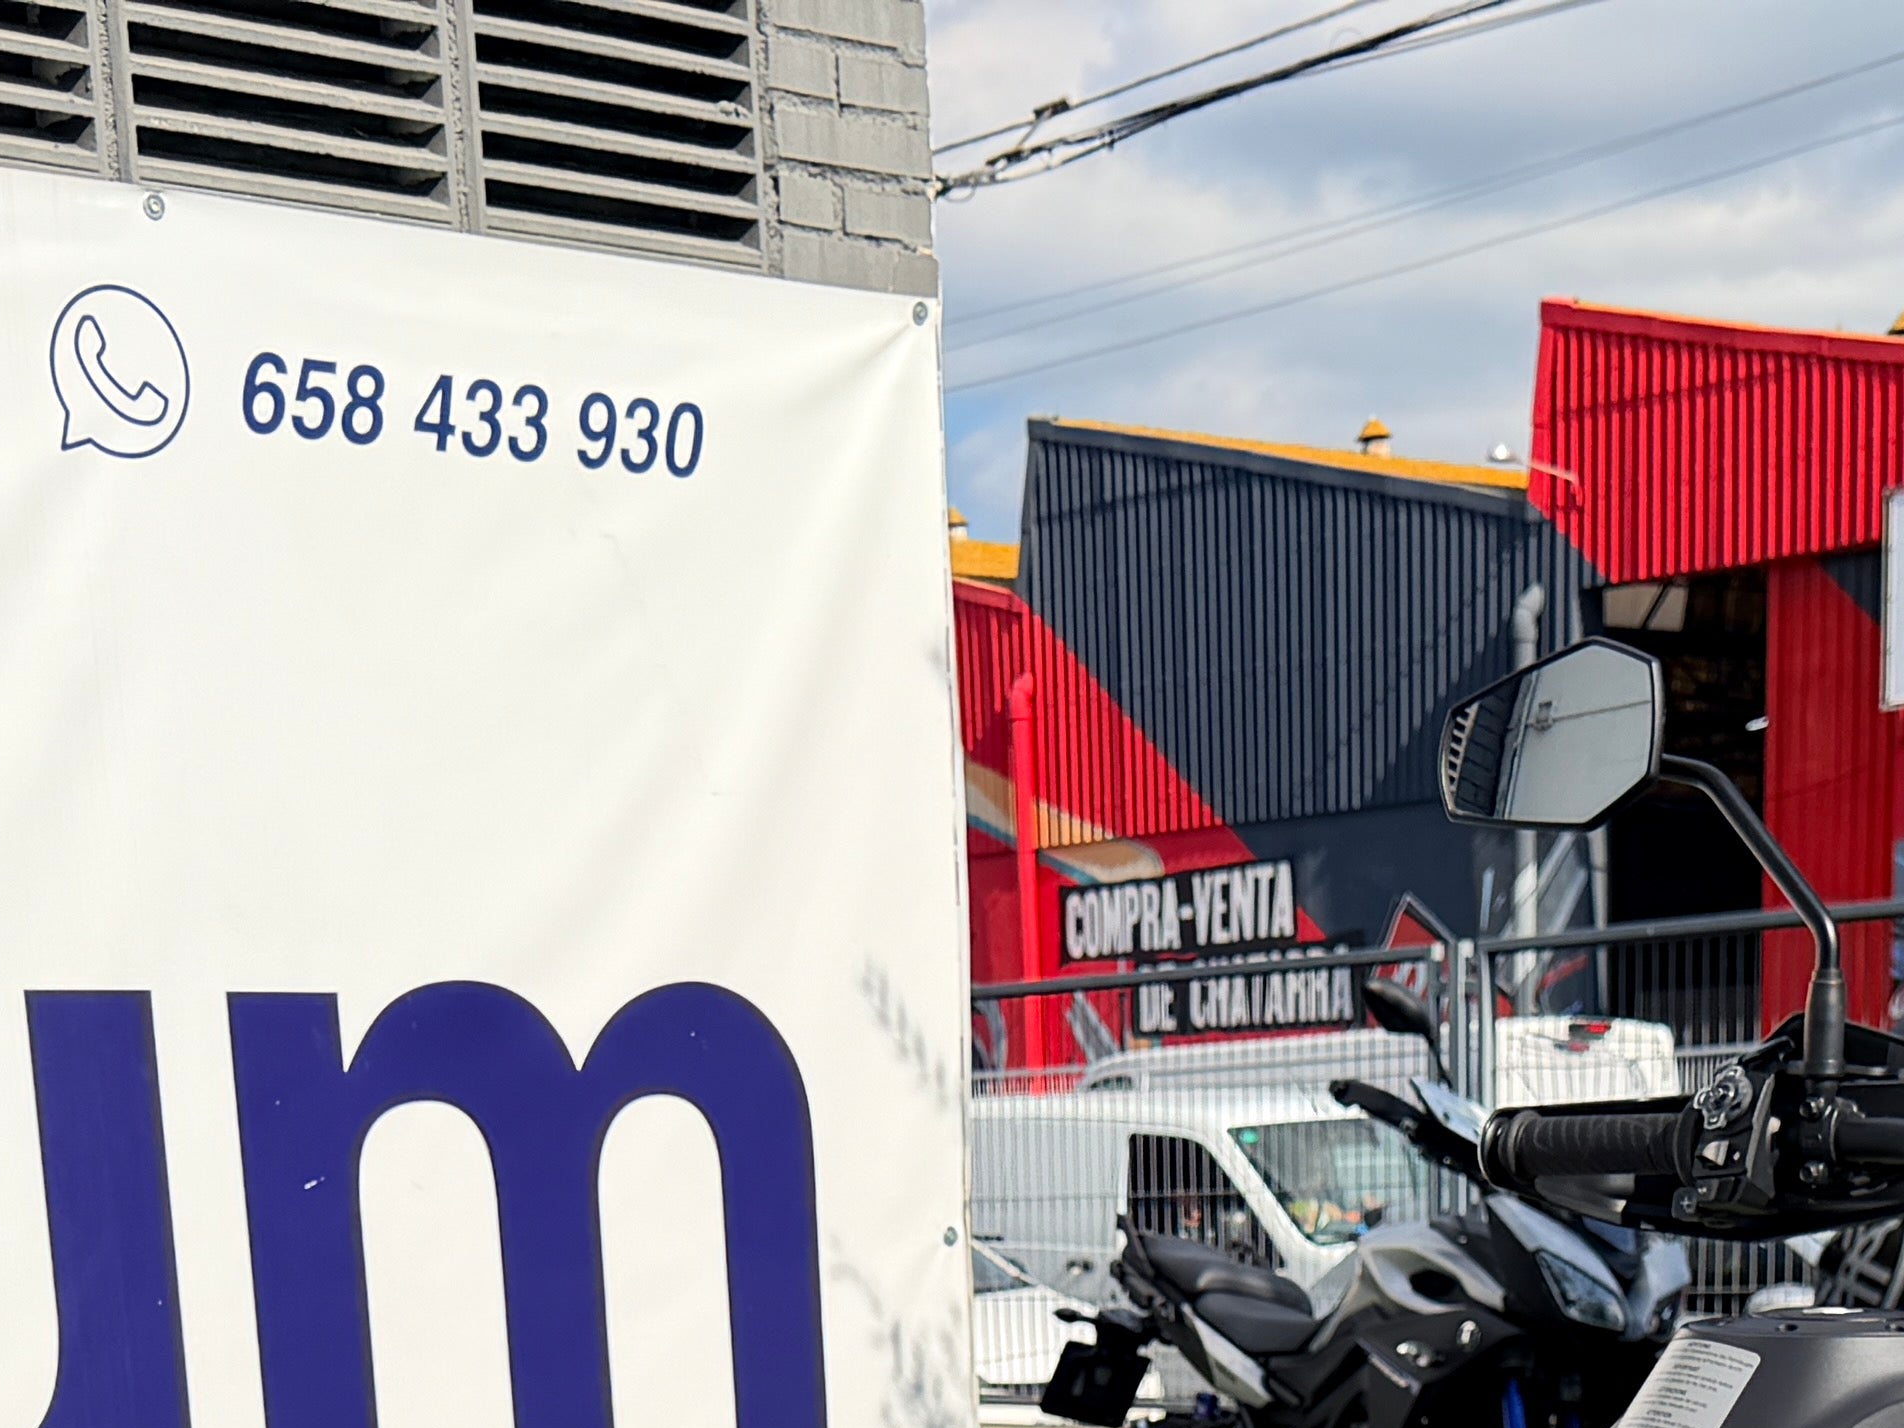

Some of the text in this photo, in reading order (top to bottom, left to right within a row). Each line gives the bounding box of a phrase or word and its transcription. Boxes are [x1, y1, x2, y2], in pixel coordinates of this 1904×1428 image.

[241, 351, 704, 479] 658 433 930
[1065, 860, 1295, 959] COMPRA-VENTA
